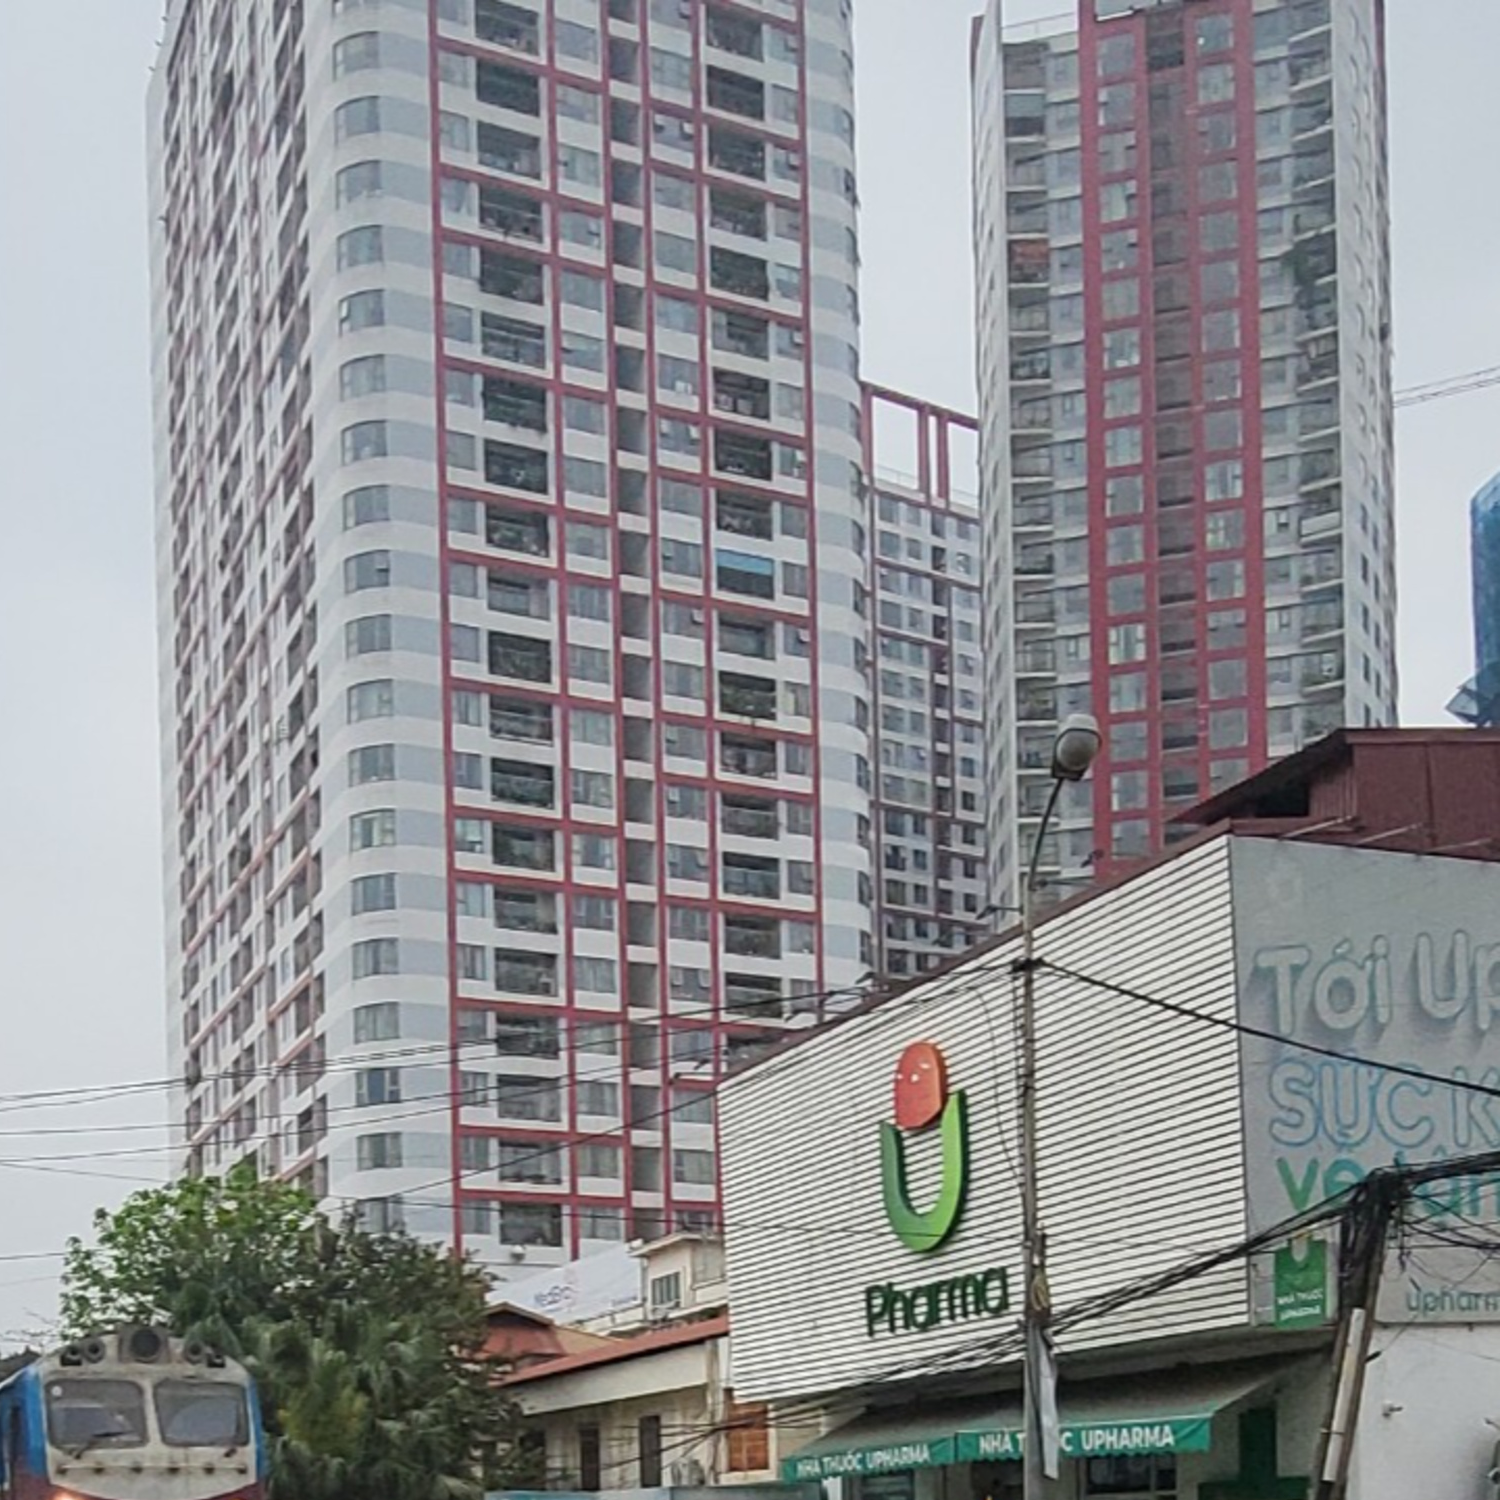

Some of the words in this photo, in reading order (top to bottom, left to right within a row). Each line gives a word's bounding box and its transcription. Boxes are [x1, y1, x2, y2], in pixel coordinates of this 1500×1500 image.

[864, 1266, 1009, 1337] Pharma
[979, 1426, 1013, 1455] NHÀ
[1081, 1425, 1175, 1452] UPHARMA
[820, 1449, 862, 1474] THUỐC
[864, 1443, 930, 1470] UPHARMA
